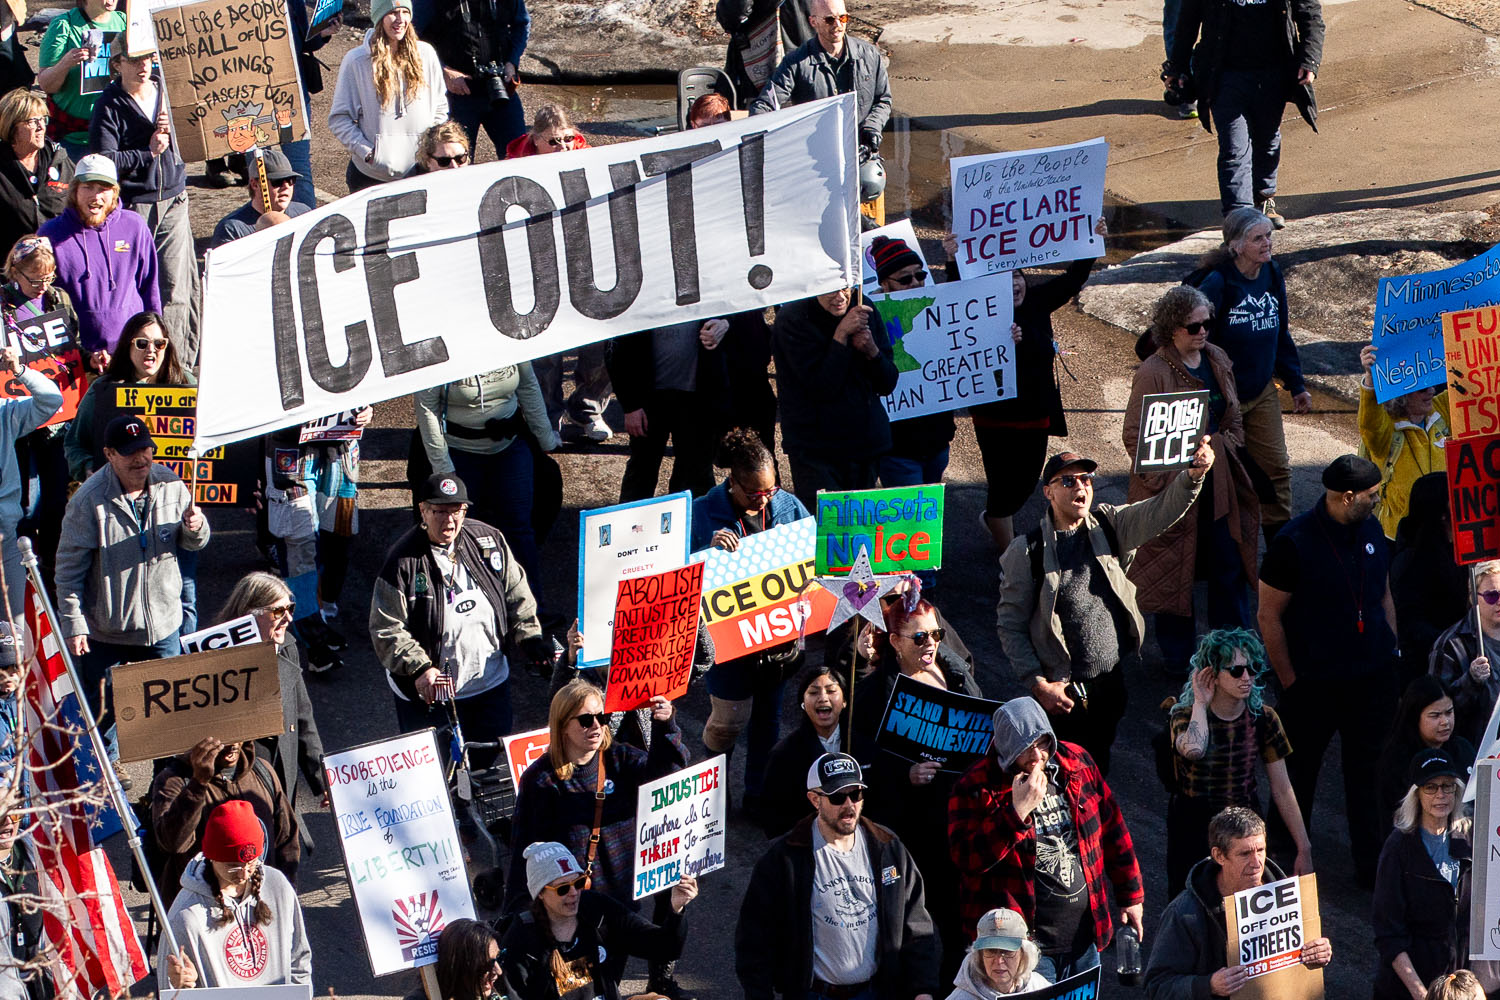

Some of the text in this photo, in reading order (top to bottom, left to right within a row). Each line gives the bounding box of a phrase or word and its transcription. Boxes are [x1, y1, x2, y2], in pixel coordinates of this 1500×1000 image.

[153, 17, 185, 42] We
[190, 10, 227, 34] the
[227, 0, 288, 30] people
[158, 20, 287, 60] MEANS ALL OF US
[188, 54, 275, 91] NO KINGS
[185, 84, 296, 127] NO FASCIST USA
[963, 149, 1089, 192] We the People
[983, 180, 1011, 199] of the
[970, 185, 1081, 232] DECLARE
[961, 214, 1095, 265] ICE OUT!
[272, 130, 774, 411] ICE OUT!
[925, 295, 998, 331] NICE
[1381, 309, 1449, 338] Knows
[8, 317, 70, 358] ICE
[947, 327, 978, 352] IS
[1446, 351, 1462, 362] THE
[922, 344, 1010, 382] GREATER
[124, 388, 174, 415] If you
[885, 384, 925, 414] HAN
[164, 444, 189, 457] are
[1140, 429, 1198, 467] ICE
[817, 489, 938, 528] minnesota
[617, 544, 659, 559] DON'T LET
[622, 562, 655, 575] CRUELTY
[616, 564, 704, 608] ABOLISH
[702, 581, 758, 623] ICE
[613, 613, 697, 646] PREJUDICE
[614, 592, 701, 630] INJUSTICE
[738, 600, 813, 650] MSP
[187, 622, 257, 654] ICE
[611, 631, 696, 667] DISSERVICE
[609, 650, 692, 685] COWARDICE
[620, 668, 688, 702] MALICE
[143, 666, 260, 719] RESIST
[894, 691, 996, 733] STAND WITH
[886, 711, 994, 756] MINNESOTA
[326, 745, 436, 788] DISOBEDIENCE
[920, 750, 949, 763] AFL-CIO
[366, 776, 397, 799] is the
[651, 765, 720, 812] INJUSTICE
[337, 795, 445, 837] TRUE FOUNDATION
[639, 814, 682, 847] Anywhere
[350, 837, 457, 885] LIBERTY!!
[640, 836, 680, 867] THREAT
[684, 828, 697, 851] To
[636, 847, 725, 897] JUSTICE Everywhere
[1239, 881, 1299, 920] ICE
[1240, 910, 1299, 935] OFF OUR
[411, 942, 439, 959] RESIST
[1241, 924, 1302, 963] STREETS
